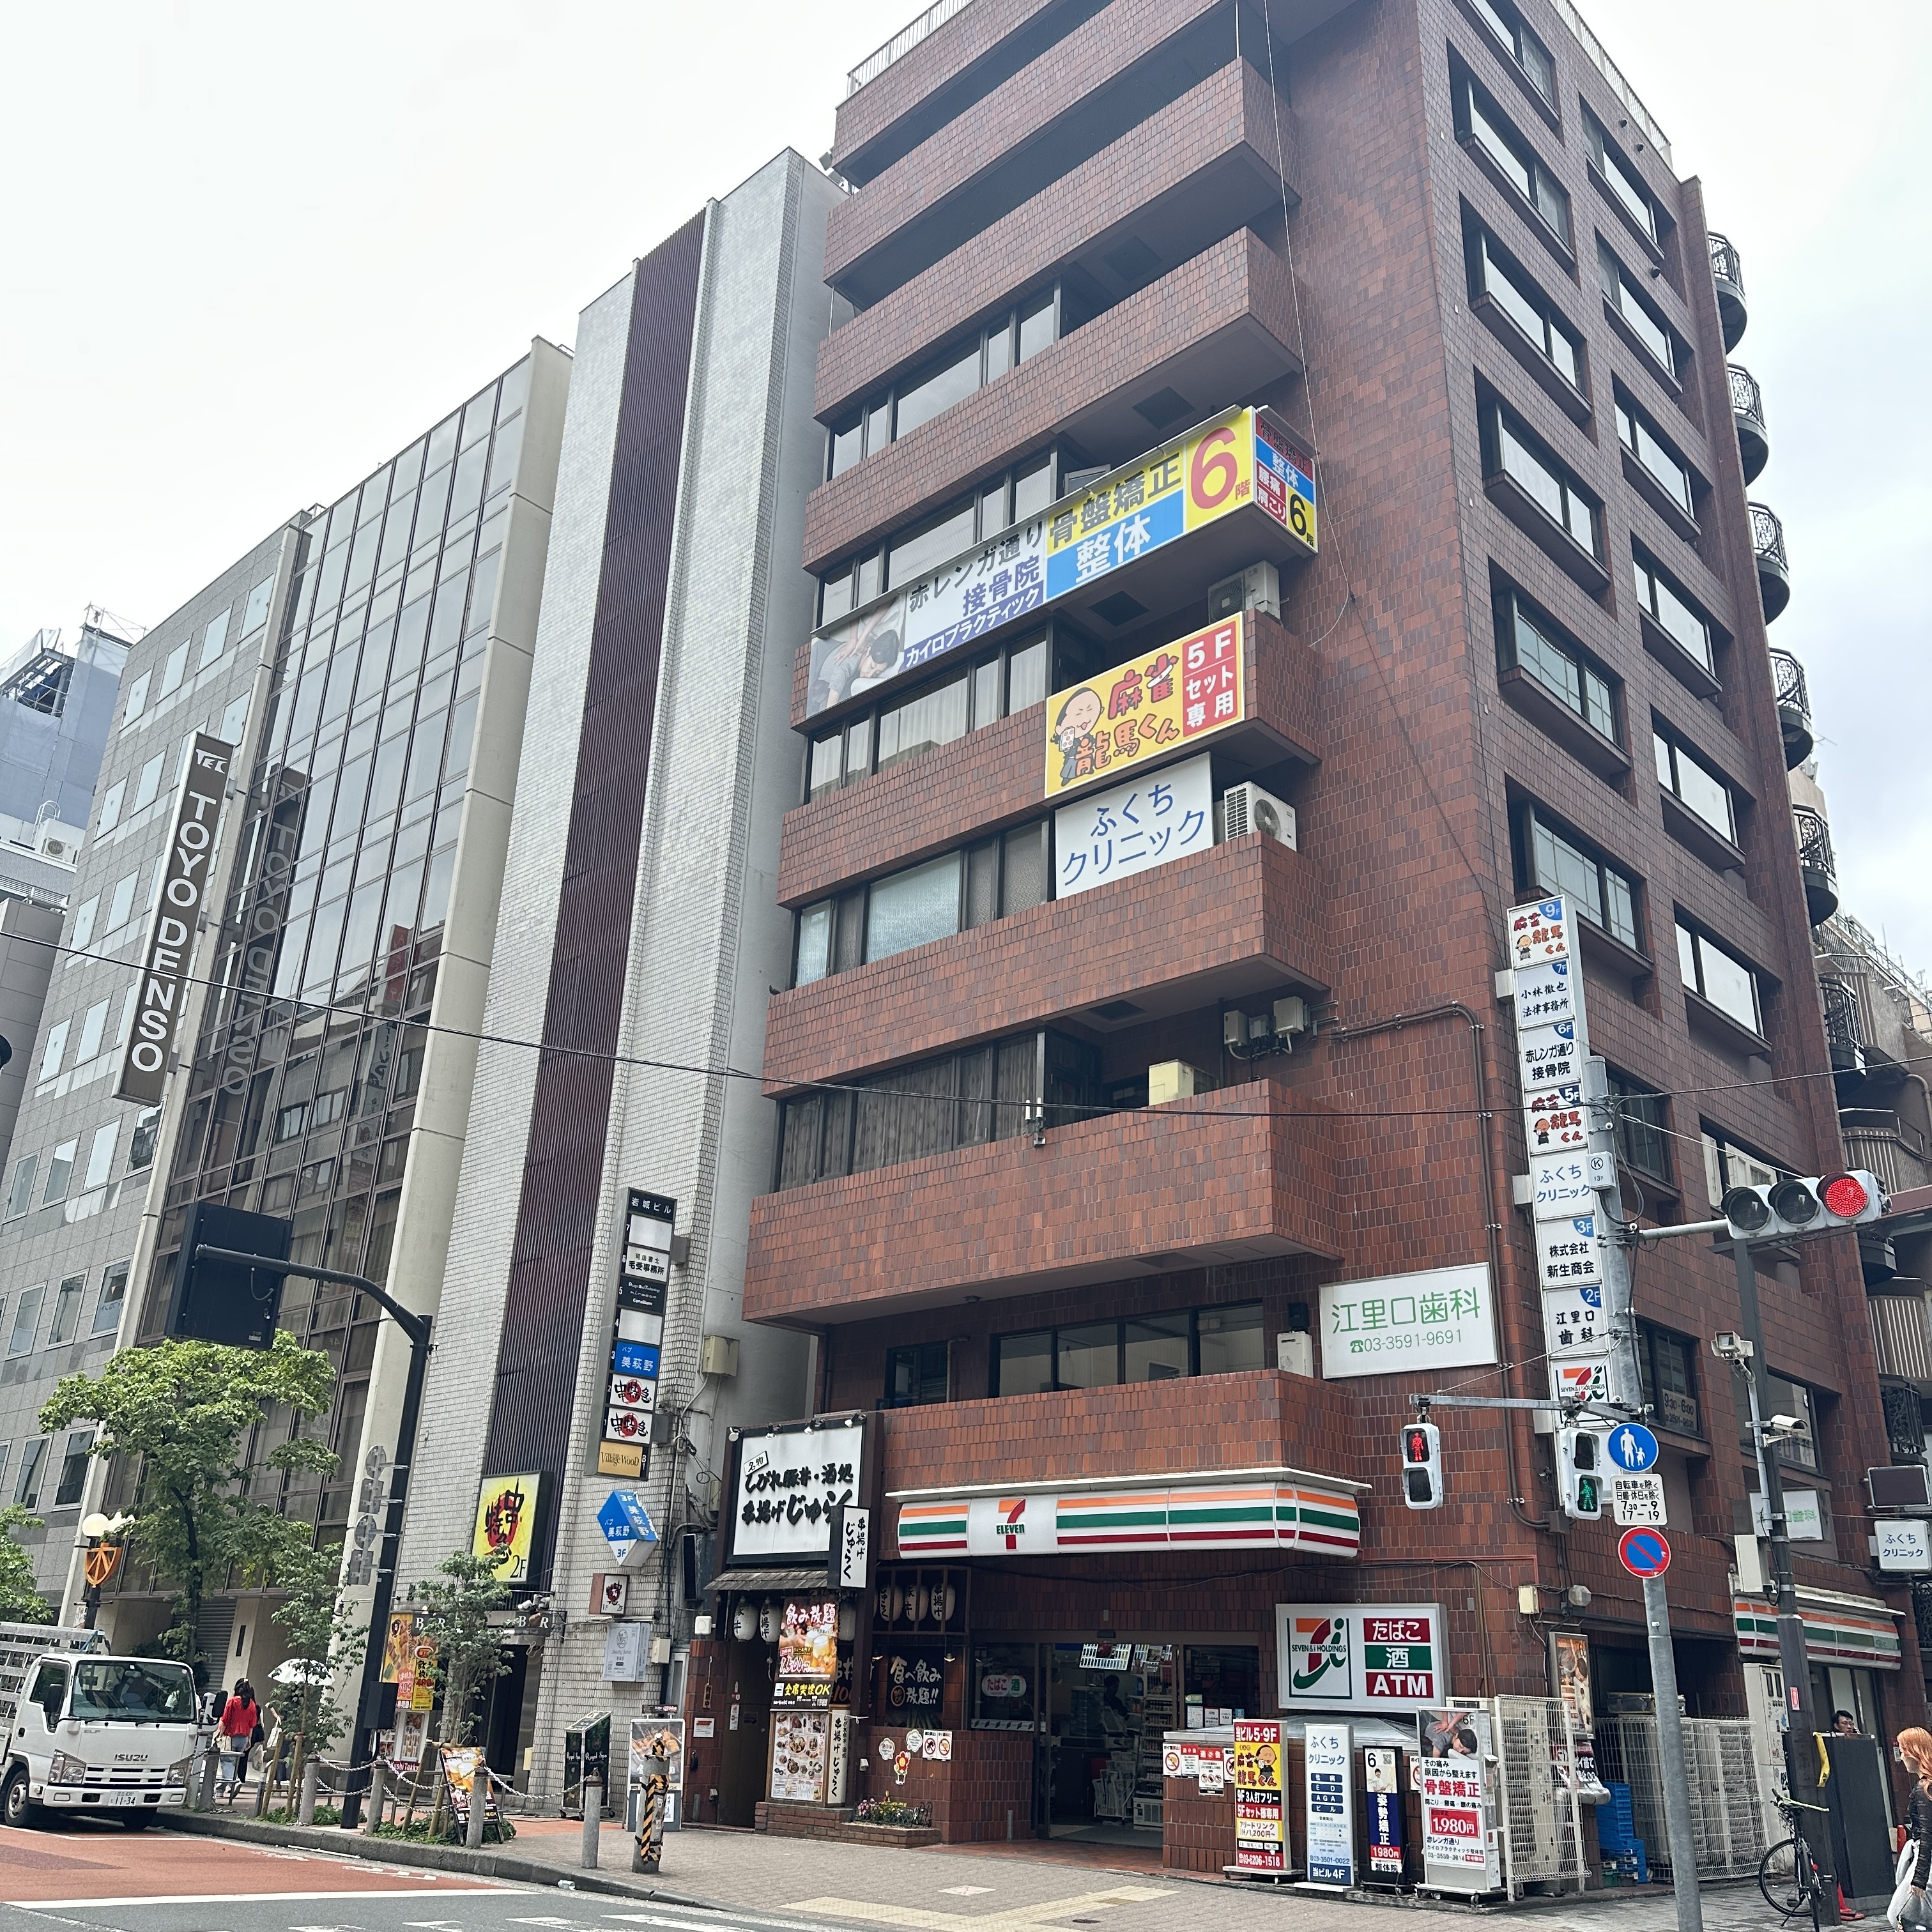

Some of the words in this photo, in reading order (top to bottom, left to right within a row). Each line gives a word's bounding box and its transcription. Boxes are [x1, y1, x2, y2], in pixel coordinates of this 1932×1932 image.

[1261, 422, 1308, 475] 骨盤矯正
[1272, 452, 1299, 487] 整体
[1259, 466, 1281, 496] 腰痛
[1050, 452, 1182, 550] 骨盤矯正
[1257, 486, 1286, 521] 肩こり
[1075, 516, 1151, 584] 整体
[909, 520, 1043, 611] 赤レンガ通り
[963, 557, 1041, 617] 接骨院
[906, 588, 1041, 668] カイロプラクティック
[1108, 654, 1177, 721] 麻雀
[1186, 669, 1234, 700] セット
[1186, 693, 1234, 728] 専用
[1075, 713, 1179, 776] 龍馬くん
[1091, 783, 1174, 838] ふくち
[167, 790, 217, 907] TOYO
[1062, 808, 1206, 885] クリニック
[1545, 903, 1561, 917] 9F
[1514, 912, 1541, 931] 麻雀
[1532, 925, 1563, 945] 龍馬
[1545, 942, 1565, 954] くん
[1557, 963, 1567, 974] 7F
[132, 916, 189, 1072] DENSO
[1522, 997, 1569, 1018] 法律事務所
[1557, 1023, 1572, 1034] 6F
[1526, 1041, 1574, 1063] 赤レンガ通り
[1532, 1061, 1571, 1080] 接骨院
[1565, 1088, 1579, 1101] 5F
[1550, 1110, 1582, 1130] 龍馬
[1560, 1130, 1584, 1143] くん
[1540, 1164, 1582, 1183] ふくち
[1537, 1184, 1590, 1203] クリニック
[631, 1197, 671, 1214] 岩城ビル
[626, 1223, 630, 1232] 7
[1577, 1220, 1592, 1234] 3F
[1549, 1241, 1589, 1257] 株式会社
[622, 1254, 627, 1263] 6
[1547, 1261, 1594, 1278] 新生商会
[618, 1286, 624, 1295] 5
[1586, 1288, 1600, 1303] 2F
[1332, 1287, 1480, 1334] 江里口歯科
[1556, 1310, 1595, 1325] 江里口
[615, 1319, 619, 1327] 4
[1364, 1330, 1462, 1353] 03-3591-9691
[1558, 1326, 1595, 1346] 歯科
[611, 1350, 615, 1360] 3
[607, 1384, 611, 1393] 2
[748, 1456, 763, 1472] 名物
[1615, 1480, 1659, 1489] 自転車を除く
[856, 1516, 866, 1561] 串揚げ
[1885, 1533, 1917, 1544] ふくち
[617, 1549, 626, 1558] 3F
[843, 1522, 855, 1580] じゅらく
[1882, 1547, 1924, 1558] クリニック
[509, 1554, 526, 1579] 2F
[518, 1615, 549, 1629] BR
[785, 1602, 836, 1625] 飲み放題
[1372, 1620, 1422, 1641] たばこ
[1317, 1644, 1346, 1653] HOLDINGS
[1386, 1646, 1409, 1669] 酒
[890, 1656, 942, 1684] 食べ飲み
[987, 1677, 1008, 1691] たばこ
[1011, 1678, 1020, 1692] 酒
[1374, 1674, 1427, 1696] ATM
[1462, 1715, 1475, 1725] 6F
[1310, 1736, 1339, 1749] ふくち
[1308, 1753, 1346, 1765] クリニック
[1367, 1752, 1377, 1768] 6
[1423, 1759, 1449, 1768] その痛み
[1424, 1768, 1478, 1779] 原因から整えます
[1424, 1779, 1481, 1798] 骨盤矯正
[115, 1797, 136, 1805] 11-34
[1316, 1794, 1336, 1802] AGA
[1239, 1821, 1275, 1830] フリードリンク
[1377, 1793, 1390, 1846] 姿勢矯正
[1432, 1817, 1475, 1834] 1,980円
[1427, 1836, 1460, 1846] 赤レンガ通り
[1373, 1846, 1399, 1859] 1980円
